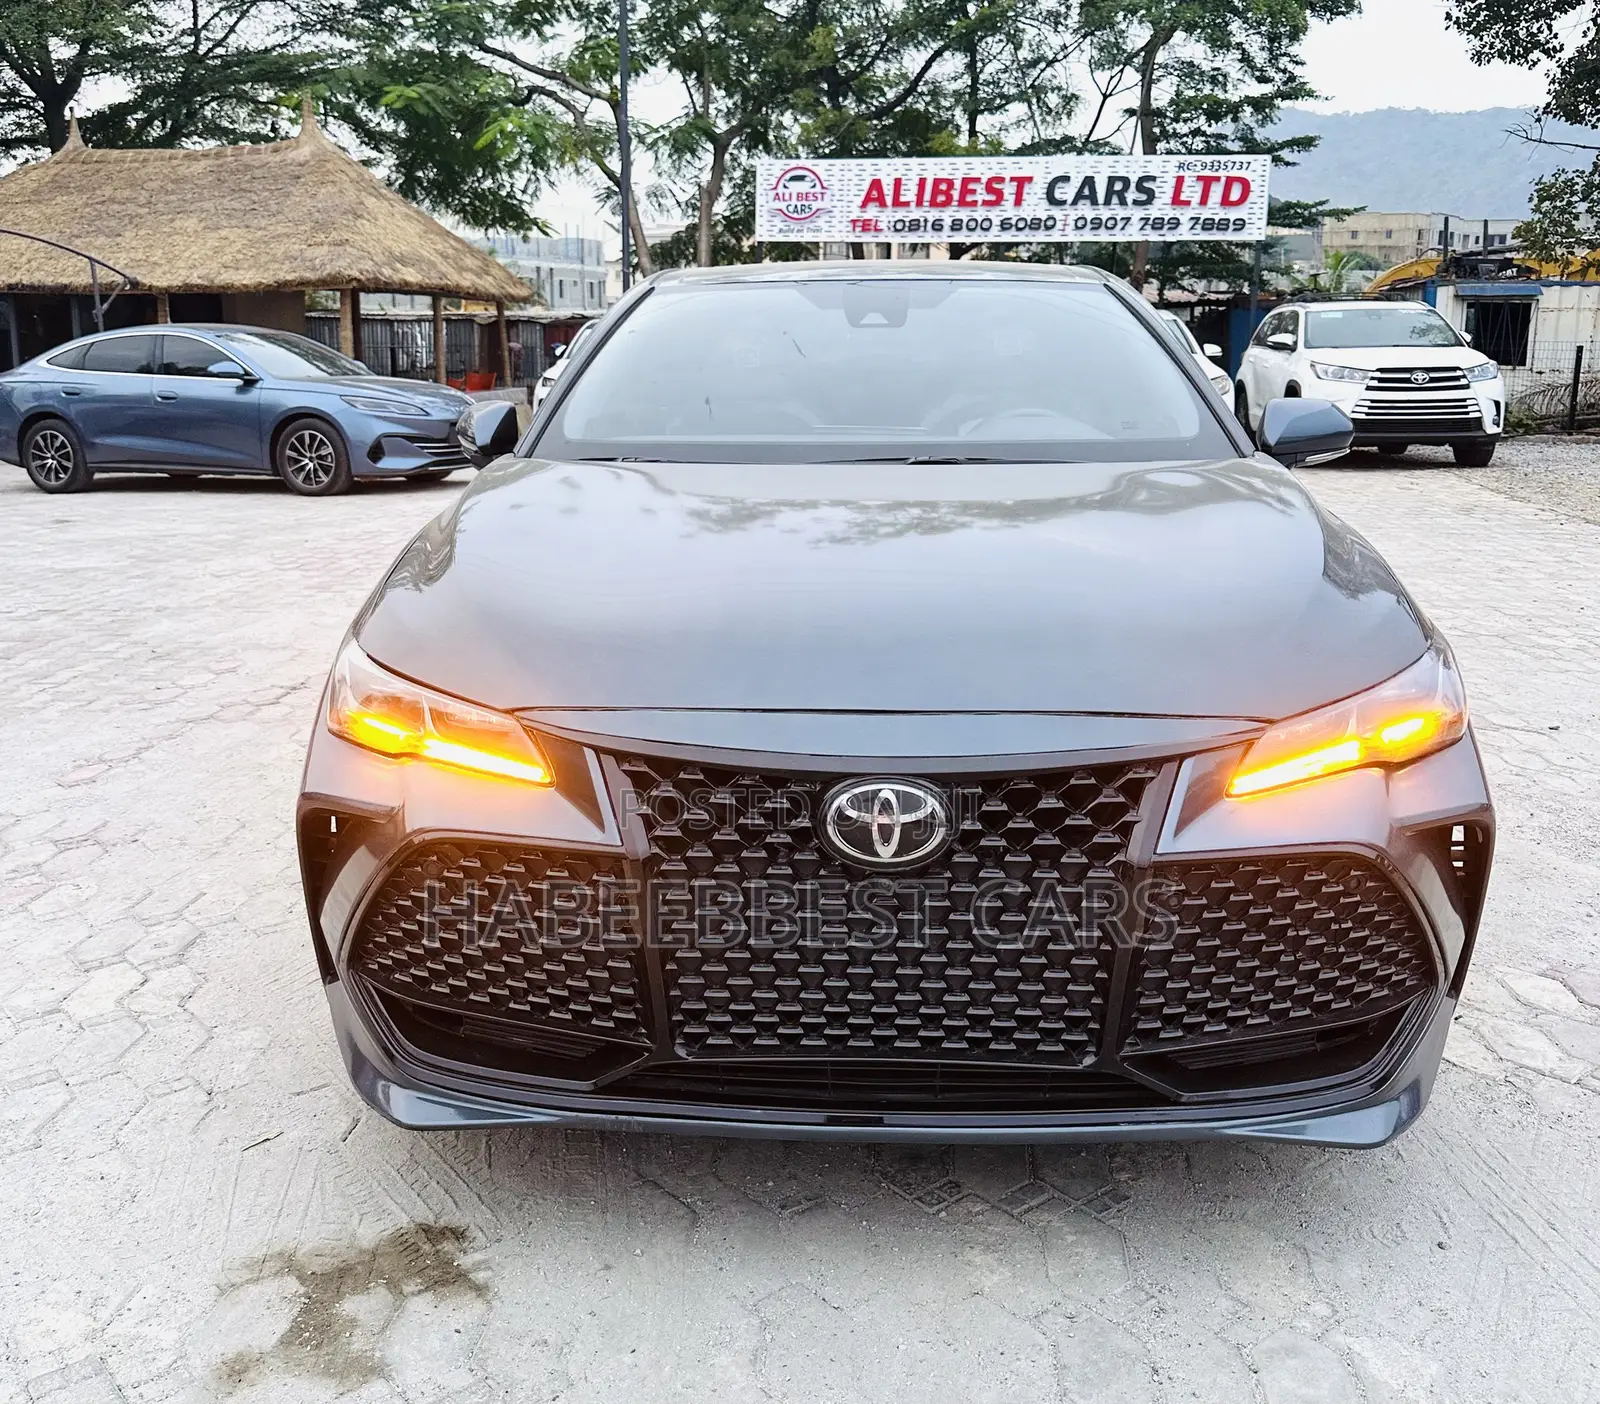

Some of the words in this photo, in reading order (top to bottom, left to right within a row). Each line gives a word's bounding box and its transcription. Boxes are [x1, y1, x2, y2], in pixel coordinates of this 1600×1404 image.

[773, 192, 793, 202] ALI
[796, 192, 827, 202] BEST
[860, 176, 1034, 209] ALIBEST
[1046, 175, 1157, 207] CARS
[1171, 175, 1251, 207] LTD
[786, 203, 813, 216] CARS
[893, 217, 945, 233] 0816
[950, 217, 993, 232] 800
[1000, 216, 1057, 232] 6080
[1074, 216, 1132, 232] 0907
[1138, 216, 1182, 232] 789
[1188, 216, 1247, 232] 7889
